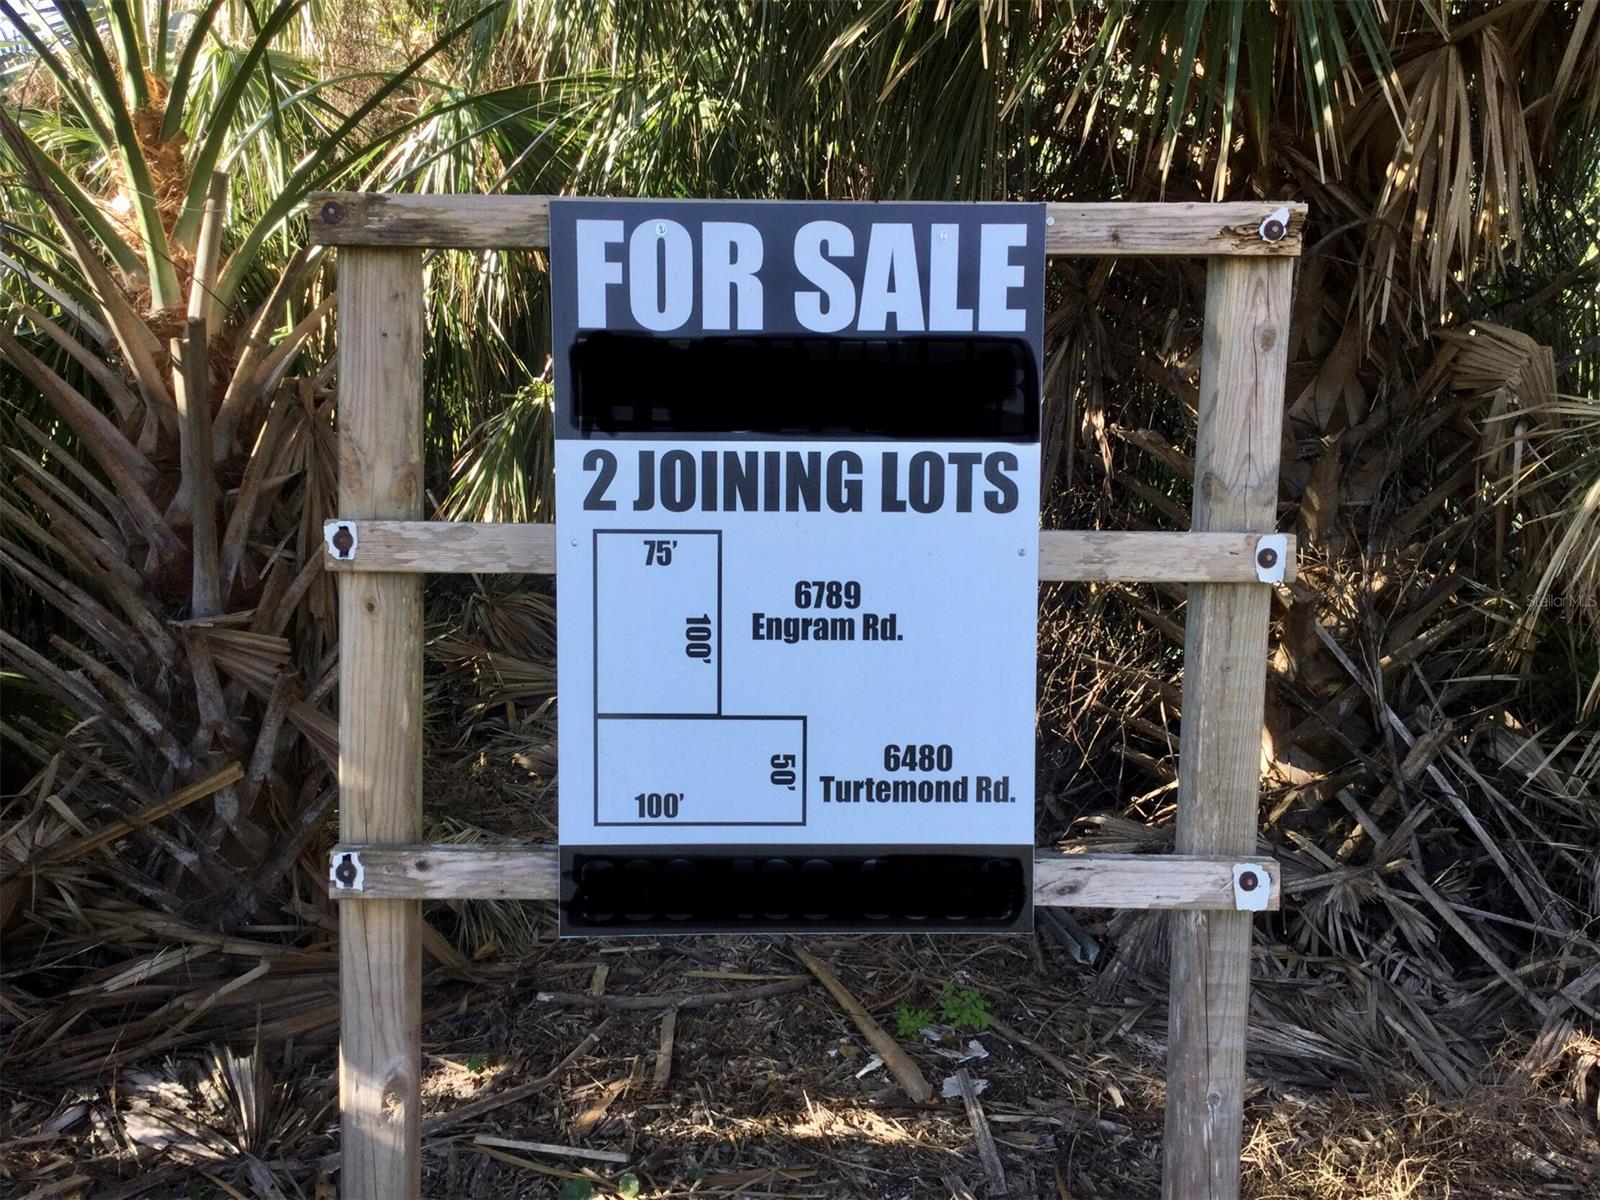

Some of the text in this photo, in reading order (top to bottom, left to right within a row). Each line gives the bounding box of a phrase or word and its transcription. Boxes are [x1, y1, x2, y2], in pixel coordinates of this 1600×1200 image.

[576, 218, 1027, 333] FOR SALE
[582, 450, 1019, 514] 2 JOINING LOTS
[643, 539, 679, 567] 75'
[794, 580, 861, 610] 6789
[685, 613, 712, 664] 100'
[752, 613, 904, 644] Engram Rd.
[770, 753, 796, 791] 50'
[883, 743, 953, 772] 6480
[819, 775, 1017, 804] Turtemond Rd.
[634, 792, 685, 819] 100'
